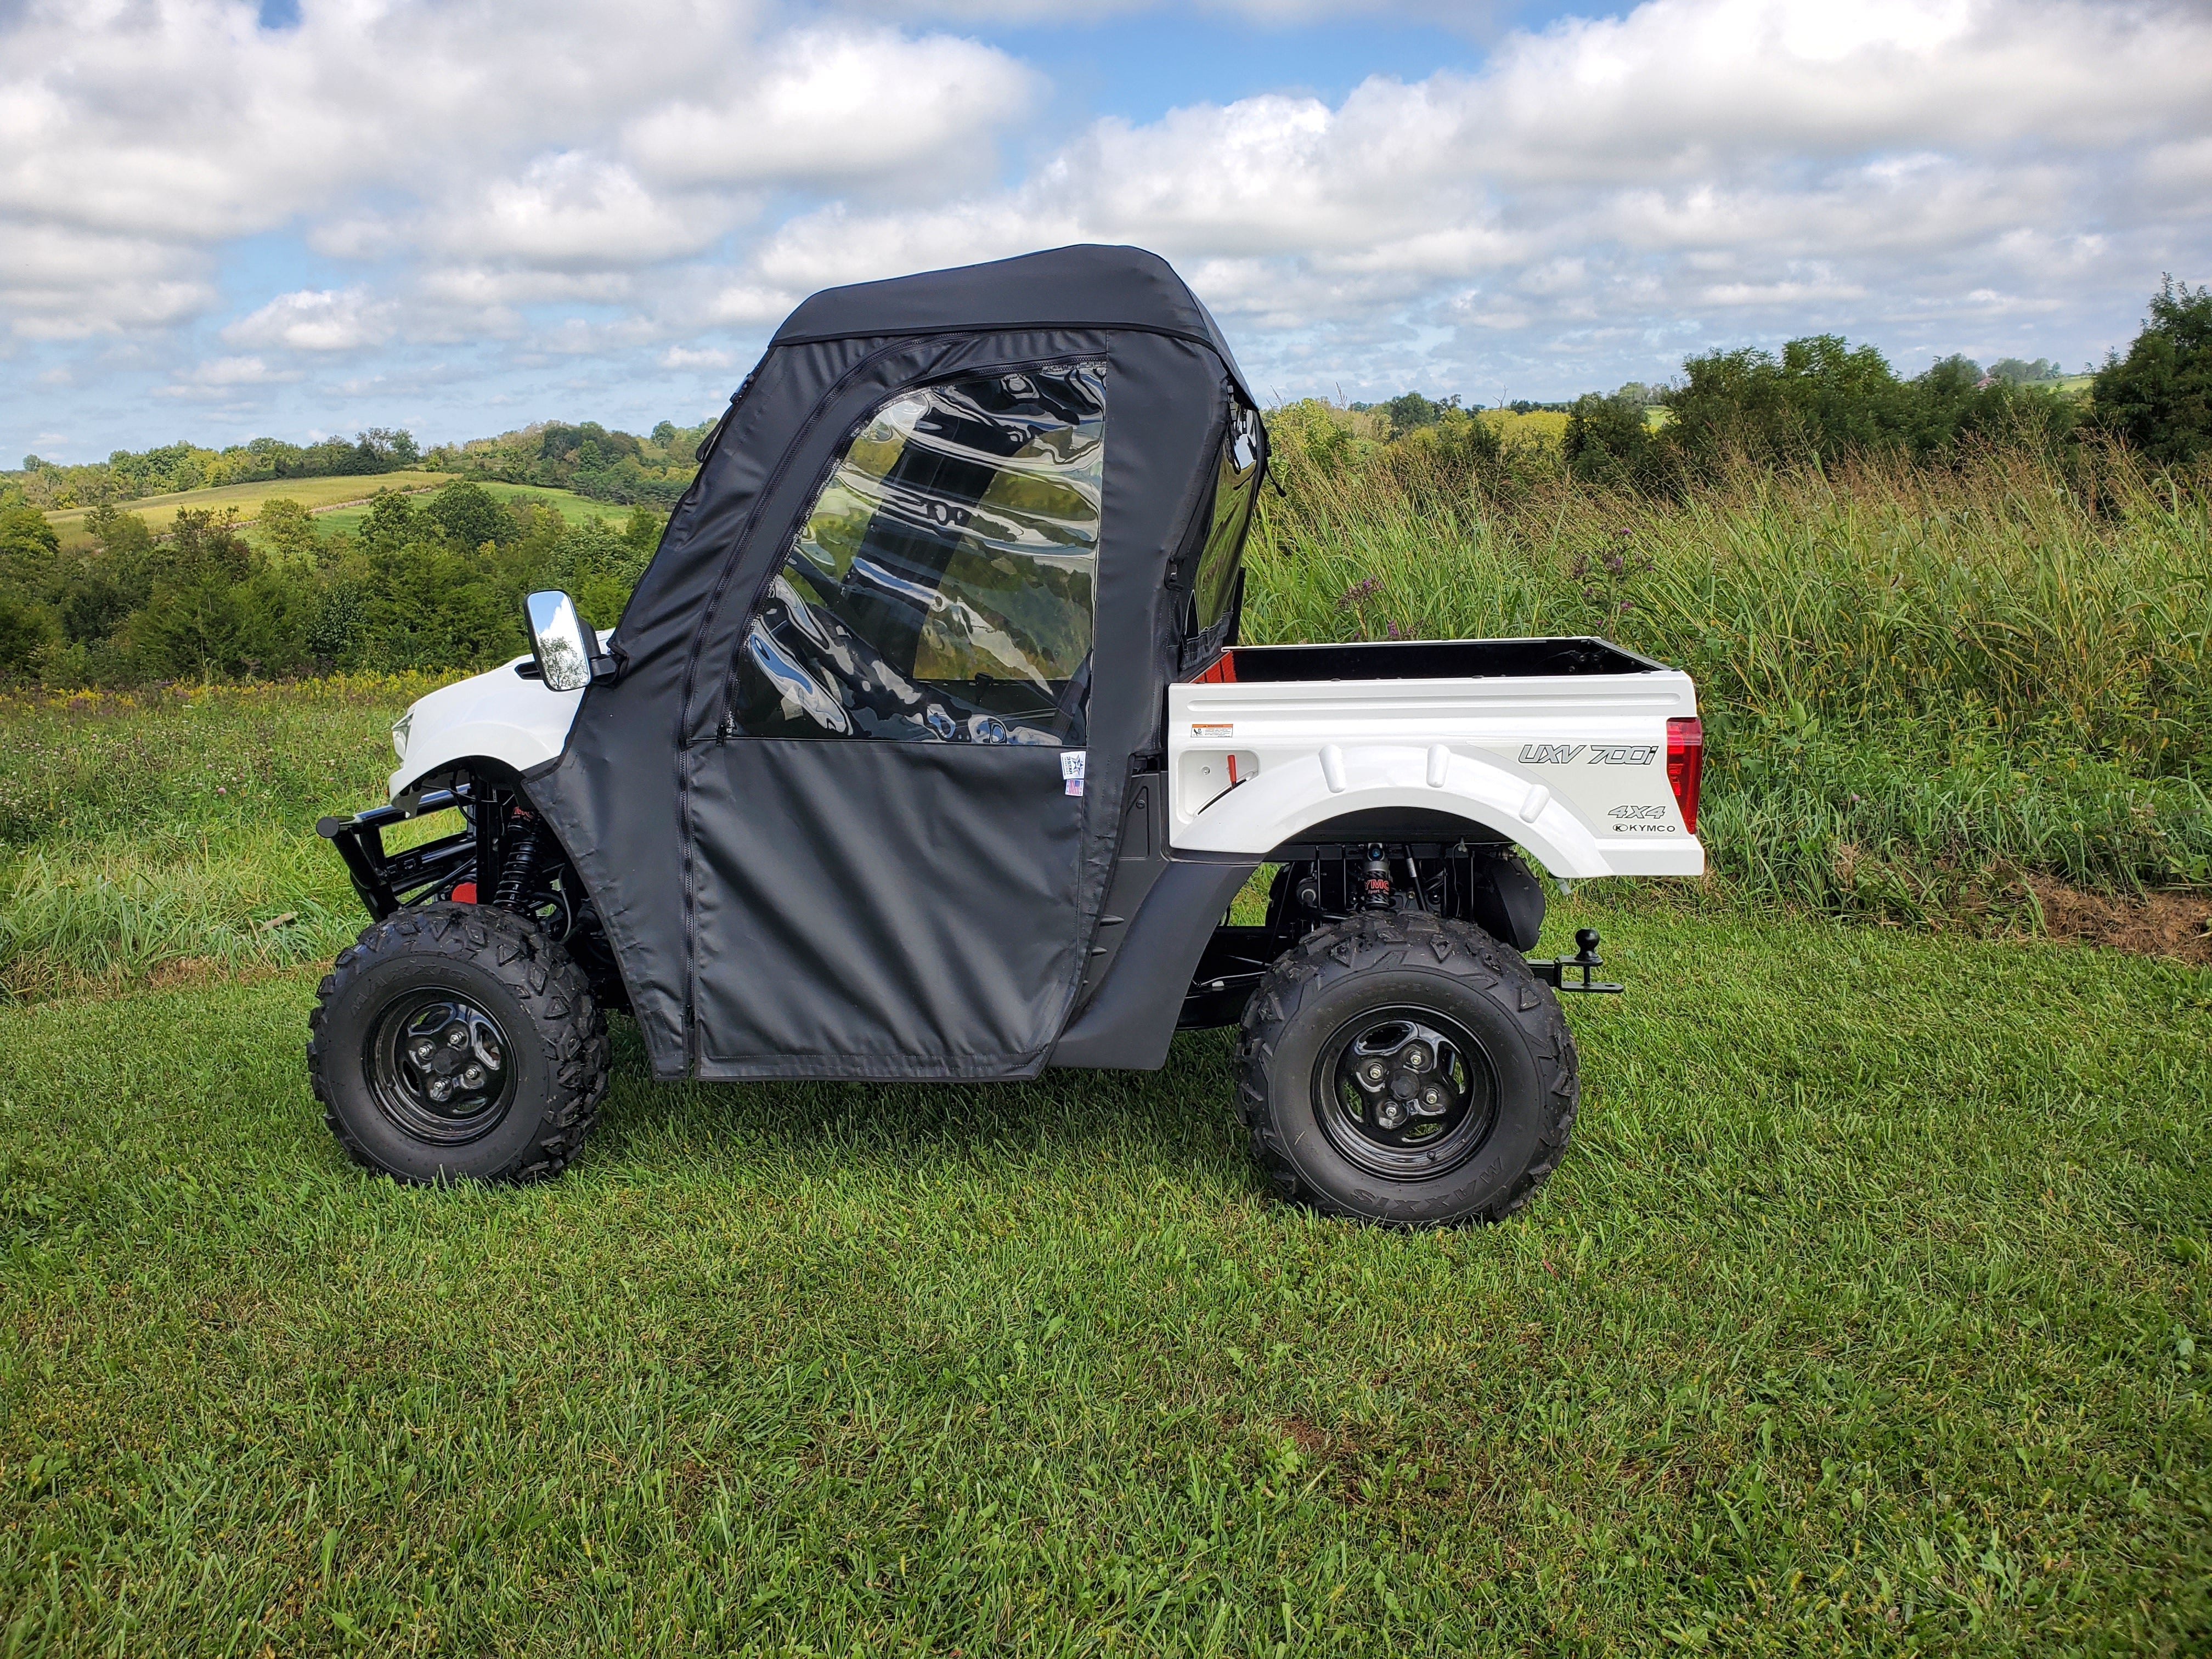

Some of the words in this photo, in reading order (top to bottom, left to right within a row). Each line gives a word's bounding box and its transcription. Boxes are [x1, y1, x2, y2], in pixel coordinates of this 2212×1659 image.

[1518, 744, 1587, 764] UXV
[1587, 745, 1659, 765] 700i
[1607, 805, 1666, 819] 4X4
[351, 964, 471, 1018] MAXXIS
[1350, 1156, 1502, 1212] MAXXIS
